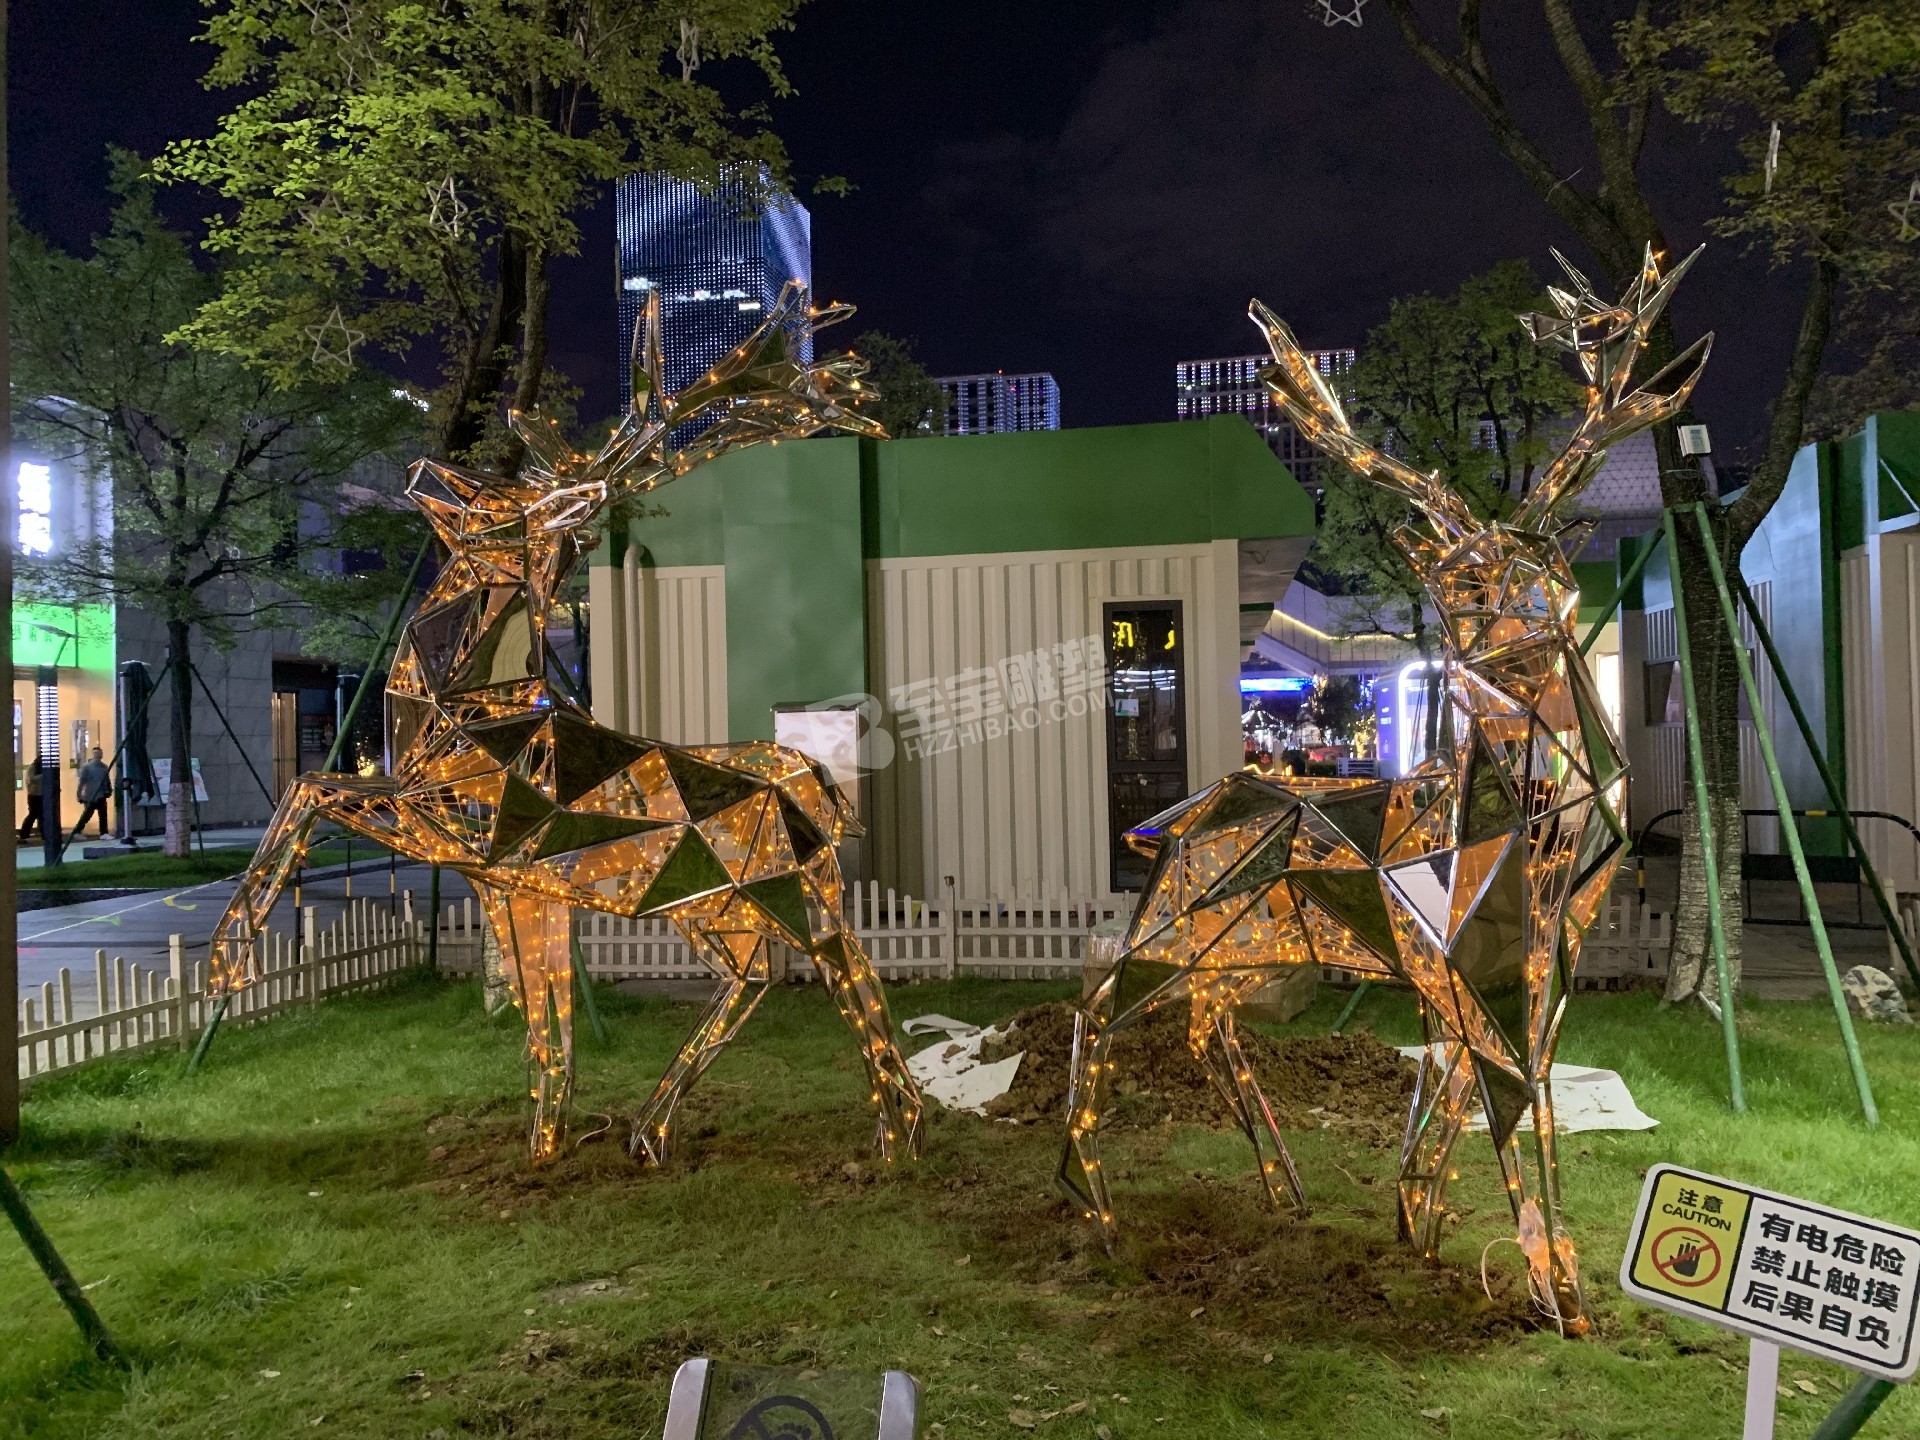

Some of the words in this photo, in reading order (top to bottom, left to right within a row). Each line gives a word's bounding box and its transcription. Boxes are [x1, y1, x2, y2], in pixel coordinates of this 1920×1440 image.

[1662, 1203, 1731, 1231] CAUTION
[1677, 1188, 1724, 1214] 注意
[1760, 1212, 1906, 1277] 有电危险
[1751, 1246, 1901, 1313] 禁止触摸
[1742, 1281, 1890, 1350] 后果自负
